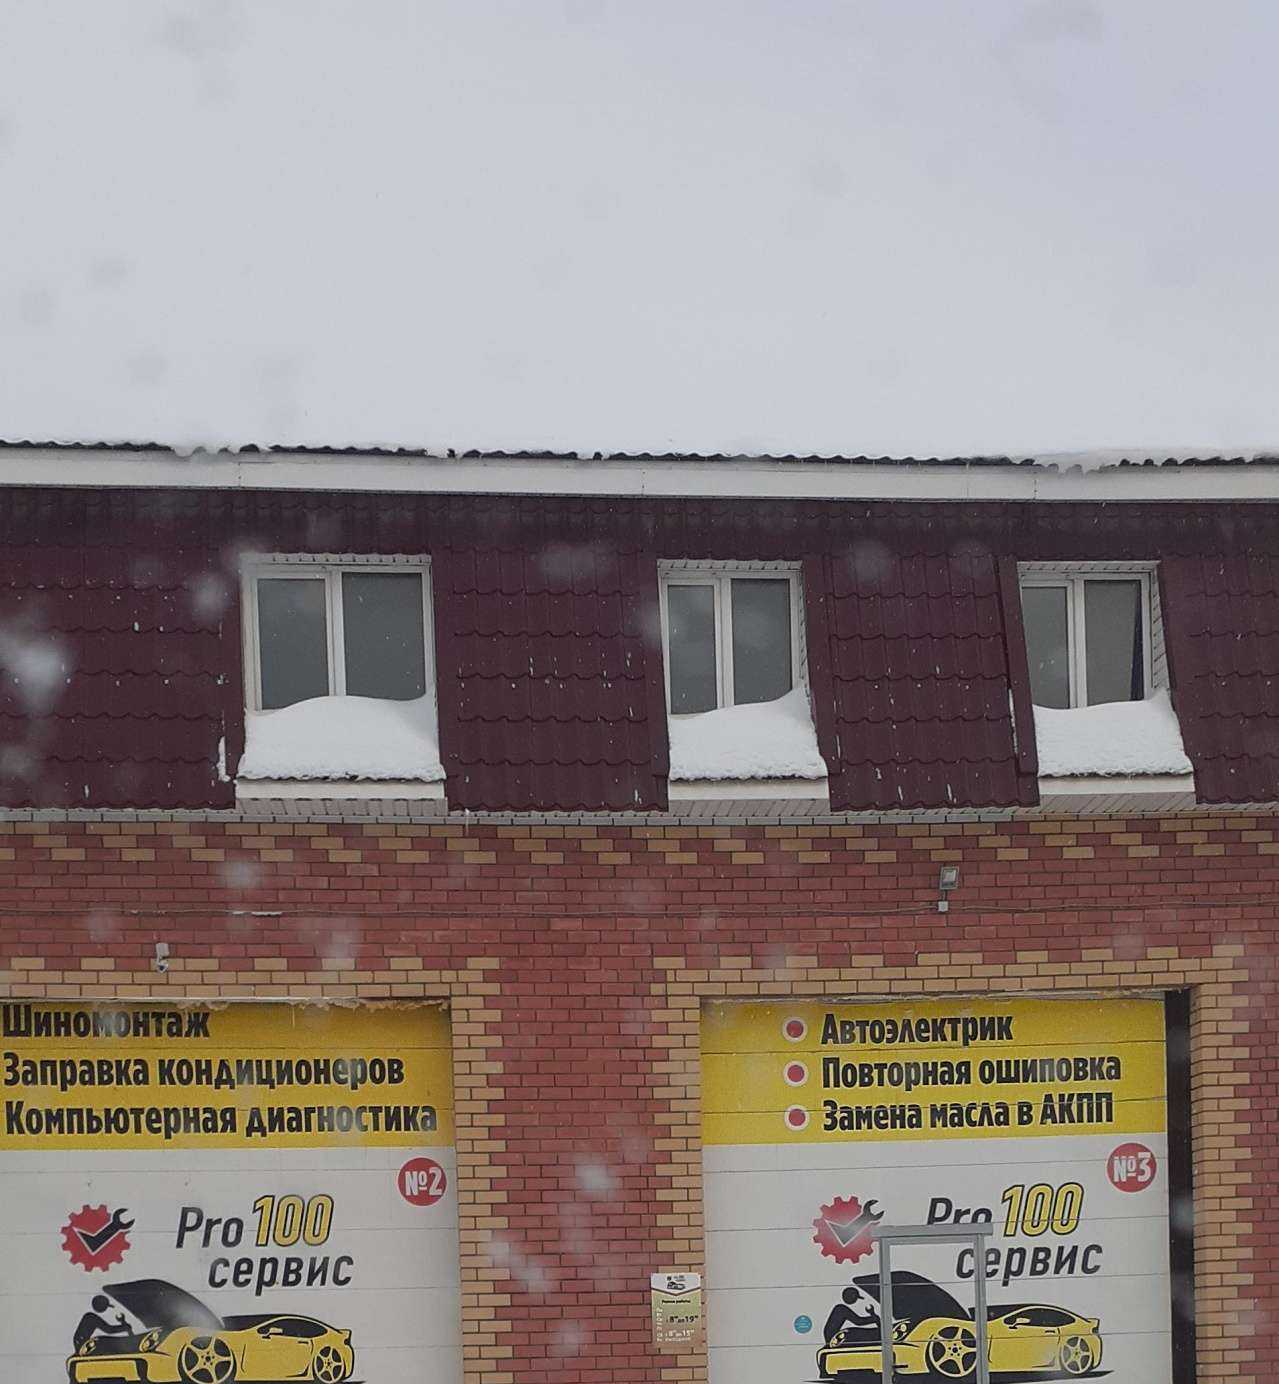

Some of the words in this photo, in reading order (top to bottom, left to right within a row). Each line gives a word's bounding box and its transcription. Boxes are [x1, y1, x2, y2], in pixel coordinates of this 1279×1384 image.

[3, 1004, 210, 1037] Шиномонтаж
[821, 1013, 1012, 1047] Автоэлектрик
[3, 1052, 149, 1091] Заправка
[158, 1057, 404, 1090] кондиционеров
[822, 1057, 971, 1092] Повторная
[978, 1056, 1121, 1083] ошиповка
[5, 1100, 237, 1139] Компьютерная
[245, 1104, 437, 1138] диагностика
[823, 1100, 922, 1132] Замена
[930, 1101, 1010, 1128] масла
[1017, 1103, 1033, 1126] в
[1039, 1092, 1113, 1125] АКПП
[176, 1206, 244, 1249] Pro
[252, 1194, 334, 1248] 100
[1001, 1182, 1084, 1237] 100
[208, 1255, 354, 1296] сервис
[956, 1244, 1102, 1287] сервис
